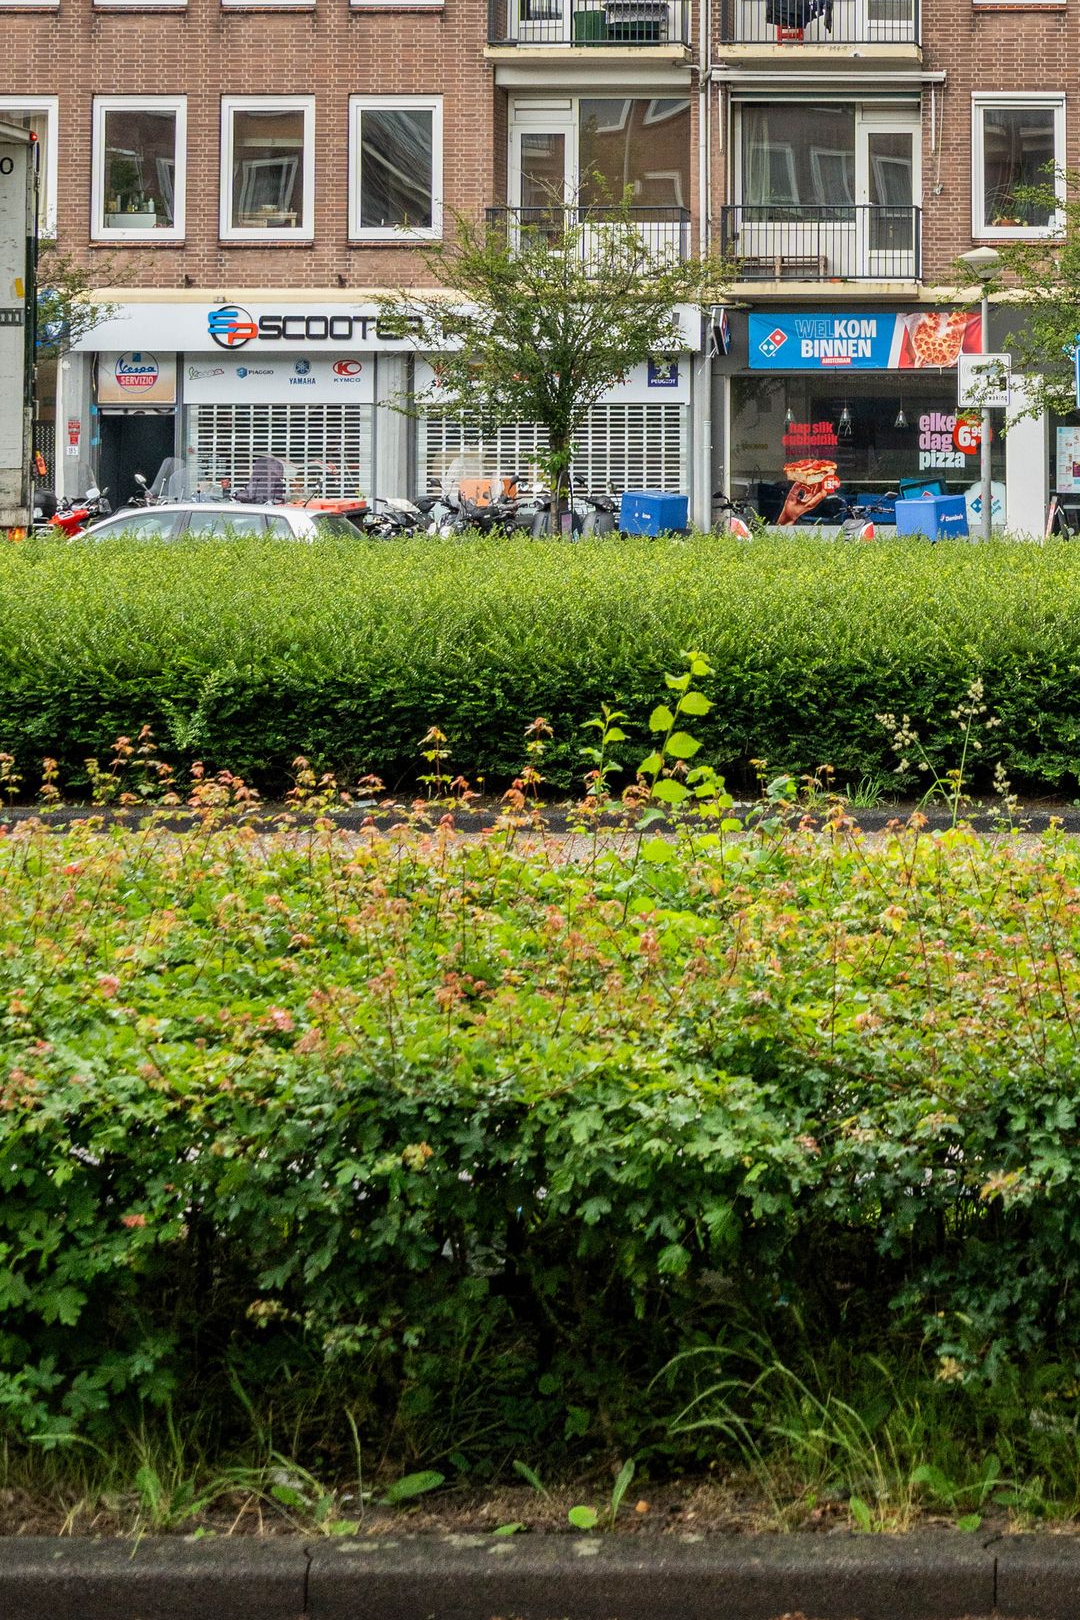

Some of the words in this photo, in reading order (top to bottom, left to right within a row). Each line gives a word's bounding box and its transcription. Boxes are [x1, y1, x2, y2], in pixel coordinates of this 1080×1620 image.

[795, 319, 877, 339] WELKOM
[801, 339, 872, 358] BINNEN
[119, 359, 157, 374] Vespa
[120, 376, 154, 385] SERVIZIO
[919, 412, 957, 432] elke
[919, 430, 953, 452] dag
[919, 450, 965, 471] pizza
